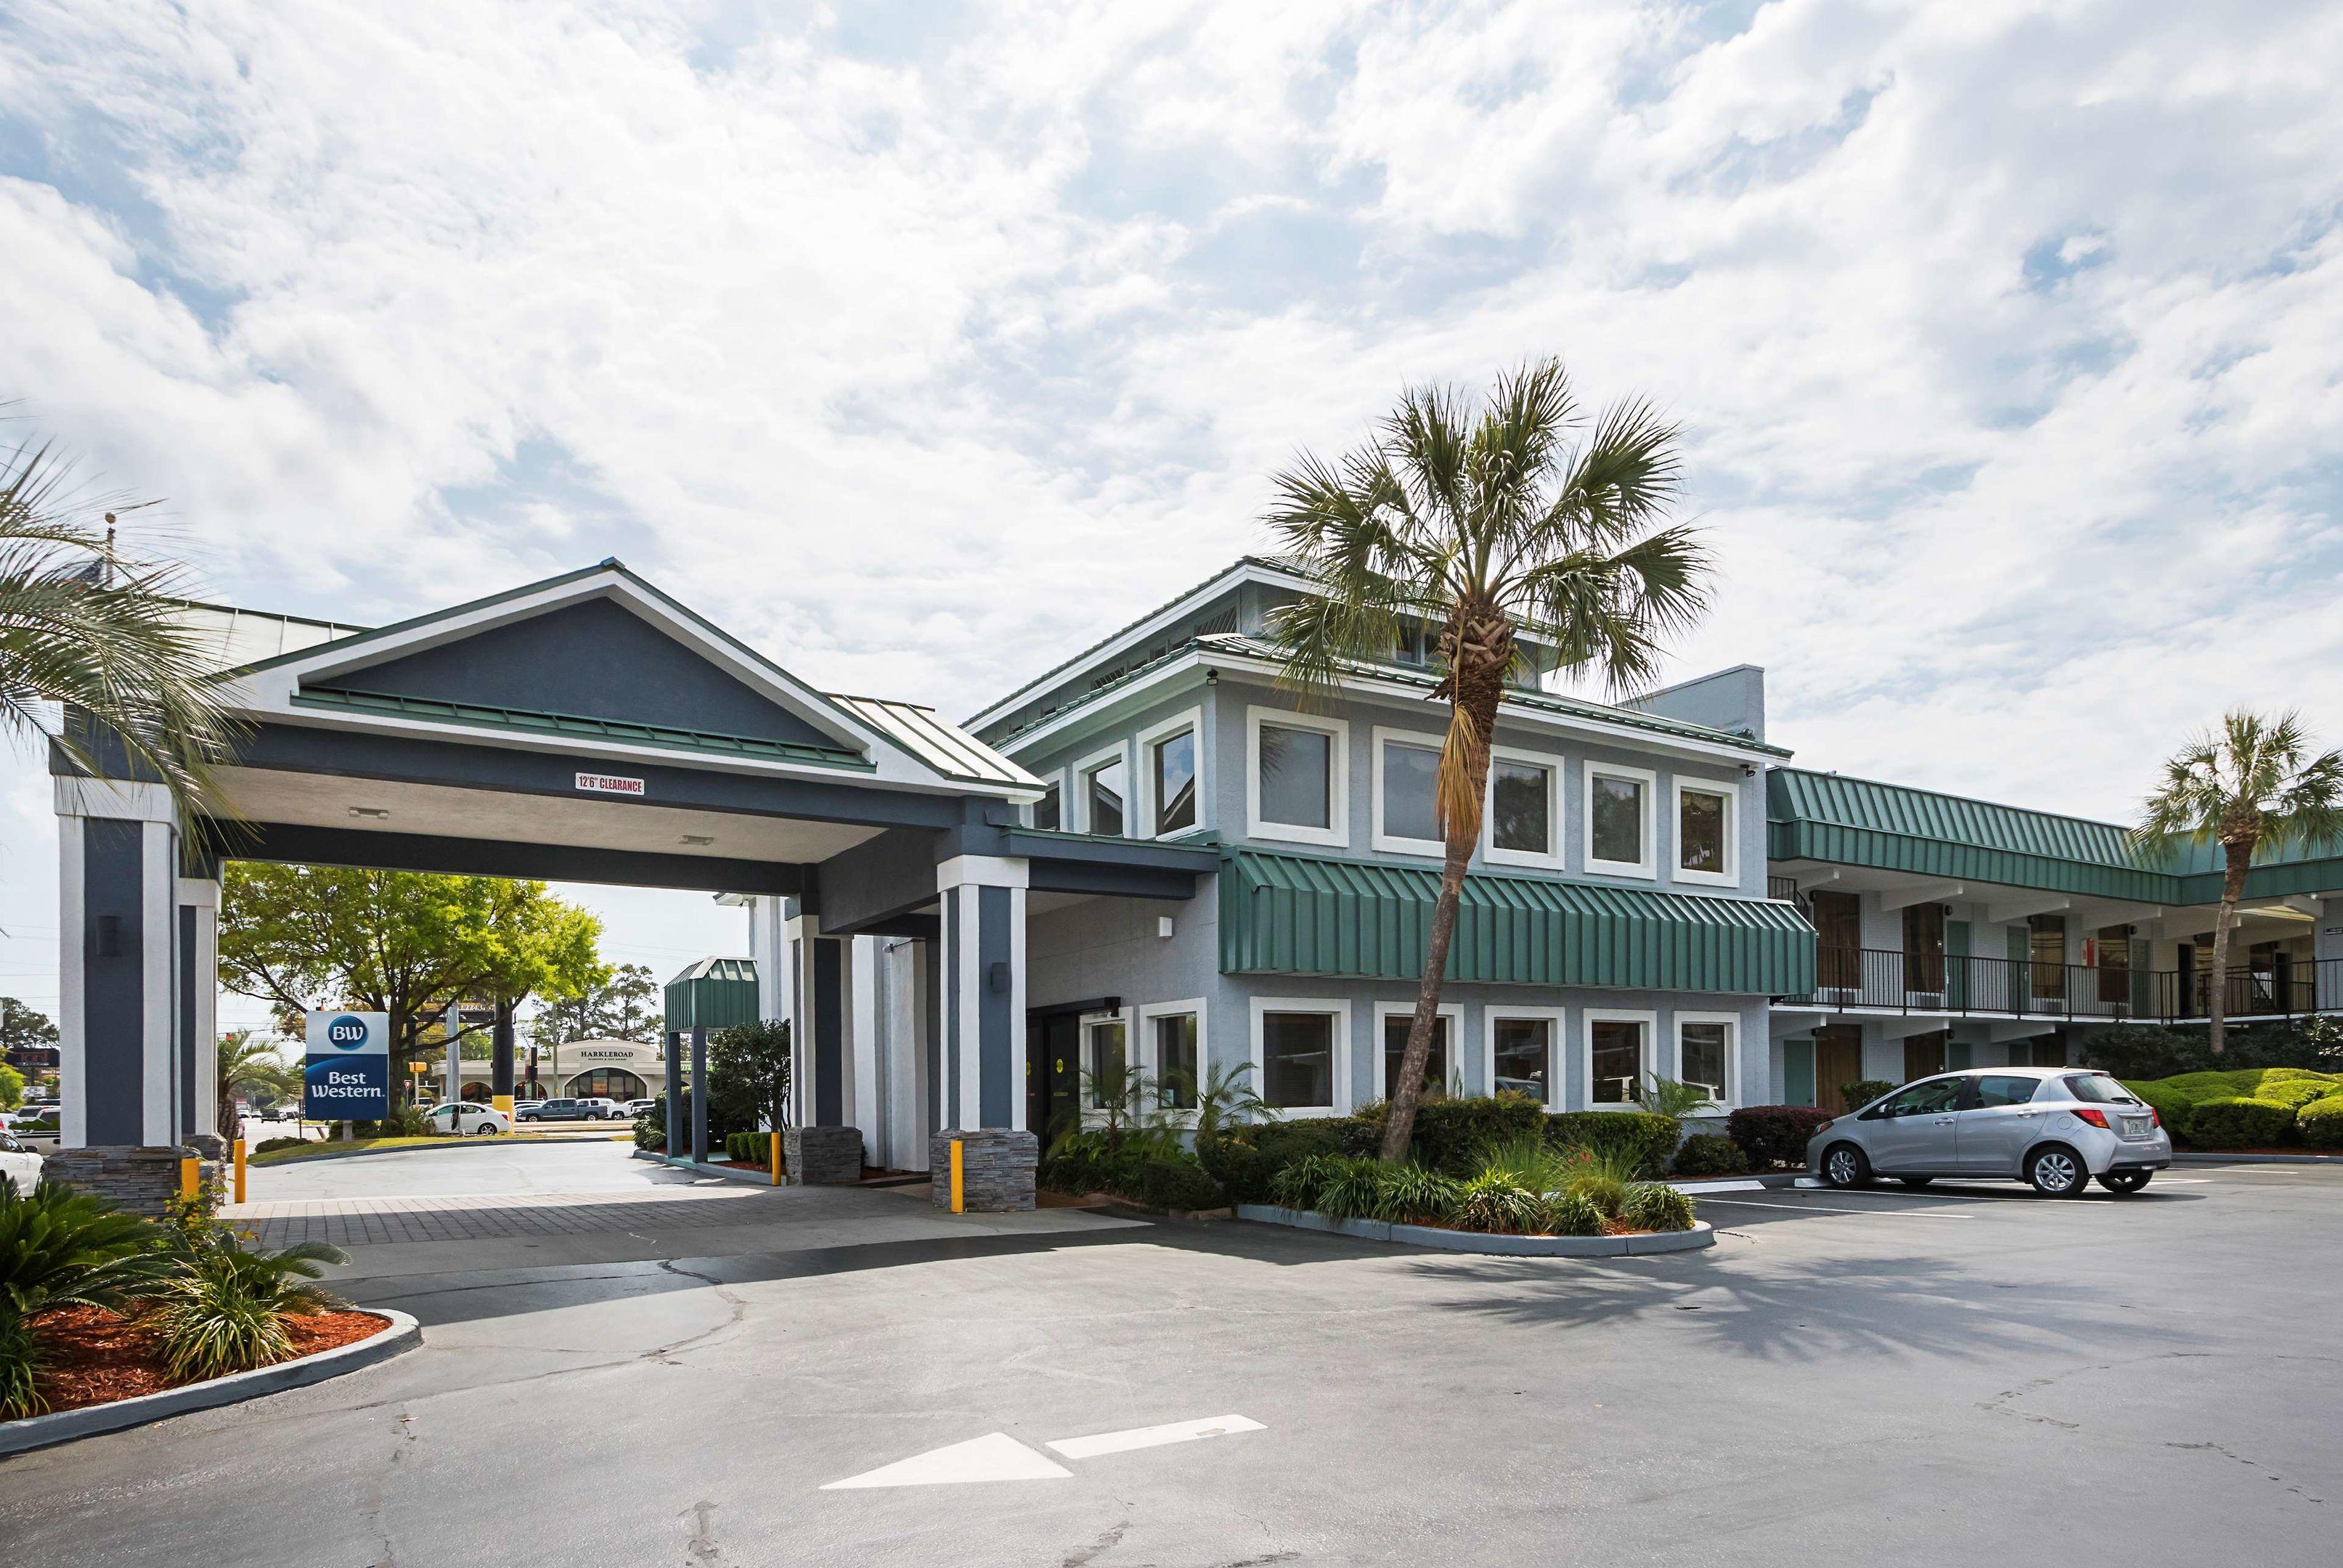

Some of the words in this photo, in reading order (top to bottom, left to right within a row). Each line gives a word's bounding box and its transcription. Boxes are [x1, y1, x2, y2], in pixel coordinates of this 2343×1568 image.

[600, 777, 642, 792] CLEARANCE
[333, 1026, 364, 1041] BW
[329, 1071, 367, 1085] Best
[311, 1085, 381, 1098] Western
